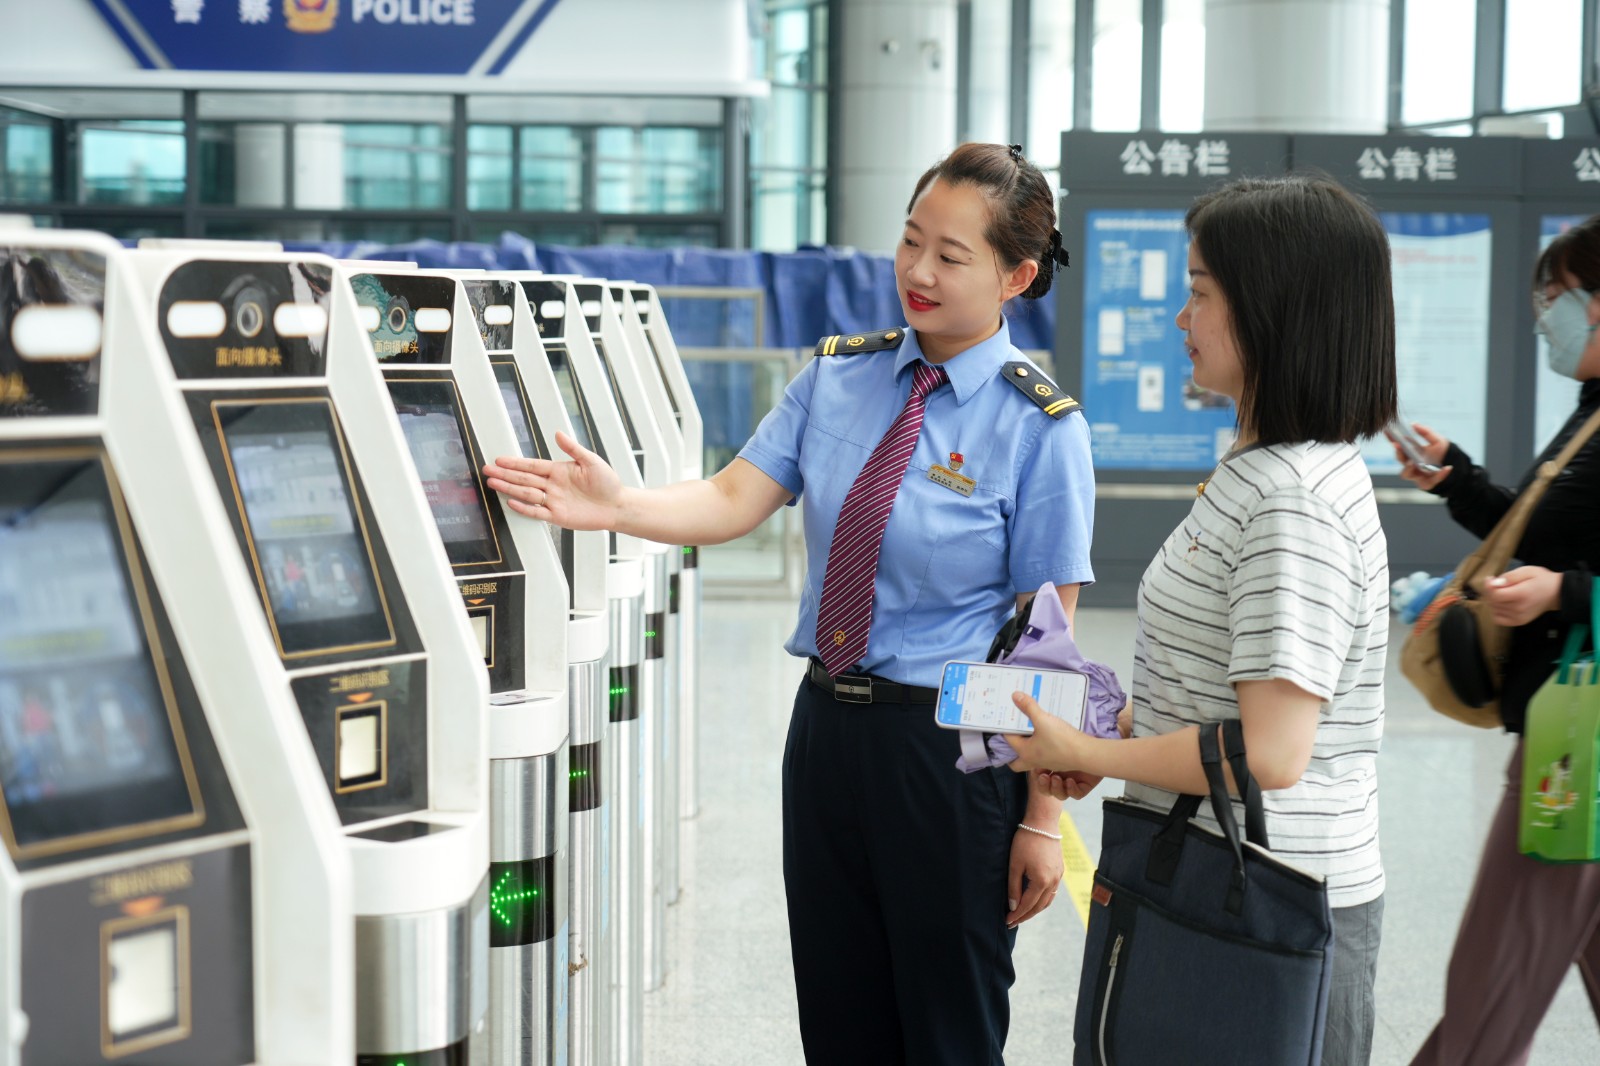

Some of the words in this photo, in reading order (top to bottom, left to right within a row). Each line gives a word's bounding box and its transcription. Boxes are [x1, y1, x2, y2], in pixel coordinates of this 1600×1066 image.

[352, 0, 474, 23] POLICE
[1120, 139, 1230, 176] 公告栏
[1357, 146, 1457, 181] 公告栏
[216, 347, 282, 367] 面向摄像头
[374, 340, 419, 353] 面向摄像头
